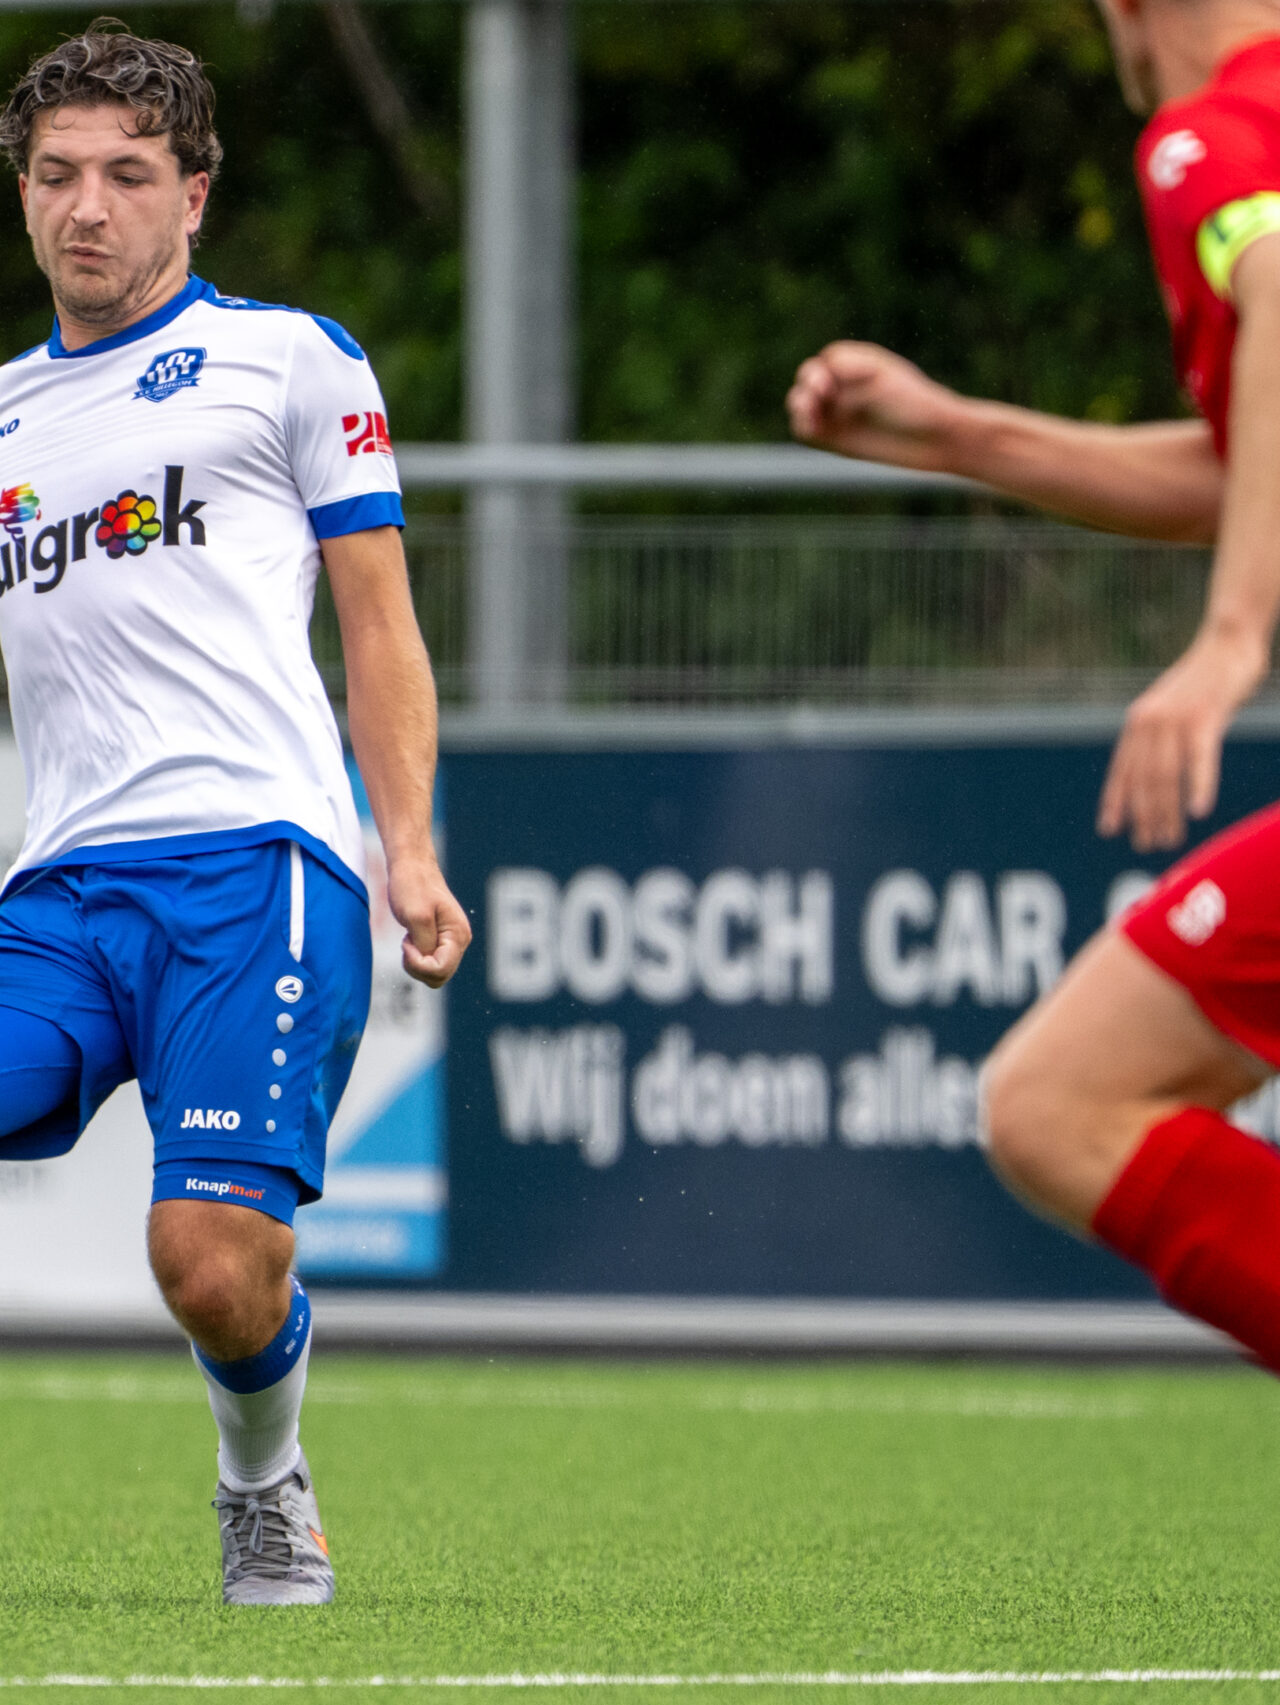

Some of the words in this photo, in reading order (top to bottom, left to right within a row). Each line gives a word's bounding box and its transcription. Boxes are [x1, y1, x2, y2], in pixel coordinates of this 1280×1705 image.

[486, 866, 834, 1005] BOSCH
[862, 868, 1066, 1006] CAR
[180, 1108, 241, 1130] JAKO
[488, 1022, 625, 1167] Wij
[632, 1023, 831, 1147] doen
